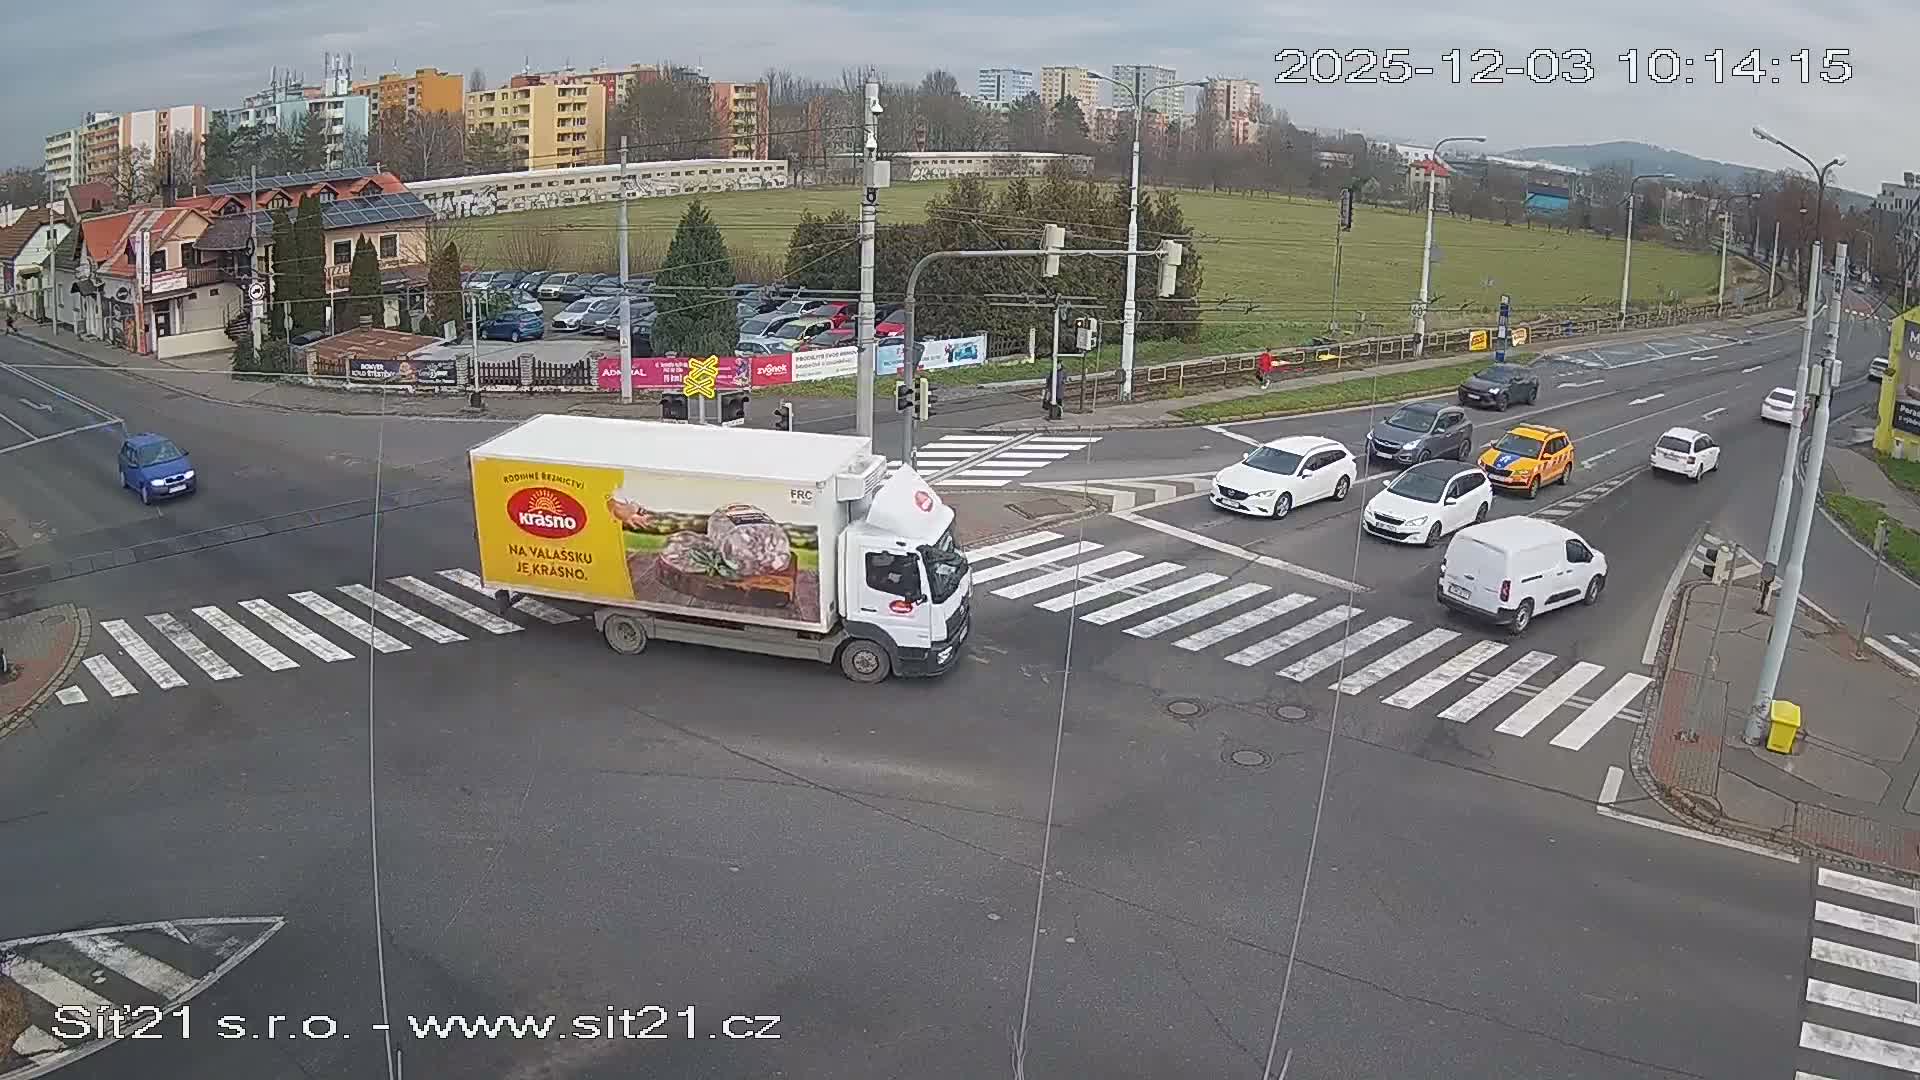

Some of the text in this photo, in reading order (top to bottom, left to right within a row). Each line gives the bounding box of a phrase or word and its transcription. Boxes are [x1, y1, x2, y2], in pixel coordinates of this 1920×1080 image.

[602, 369, 647, 377] ADMRAL
[791, 489, 813, 500] FRC
[519, 511, 577, 530] krásno
[509, 544, 527, 556] NA
